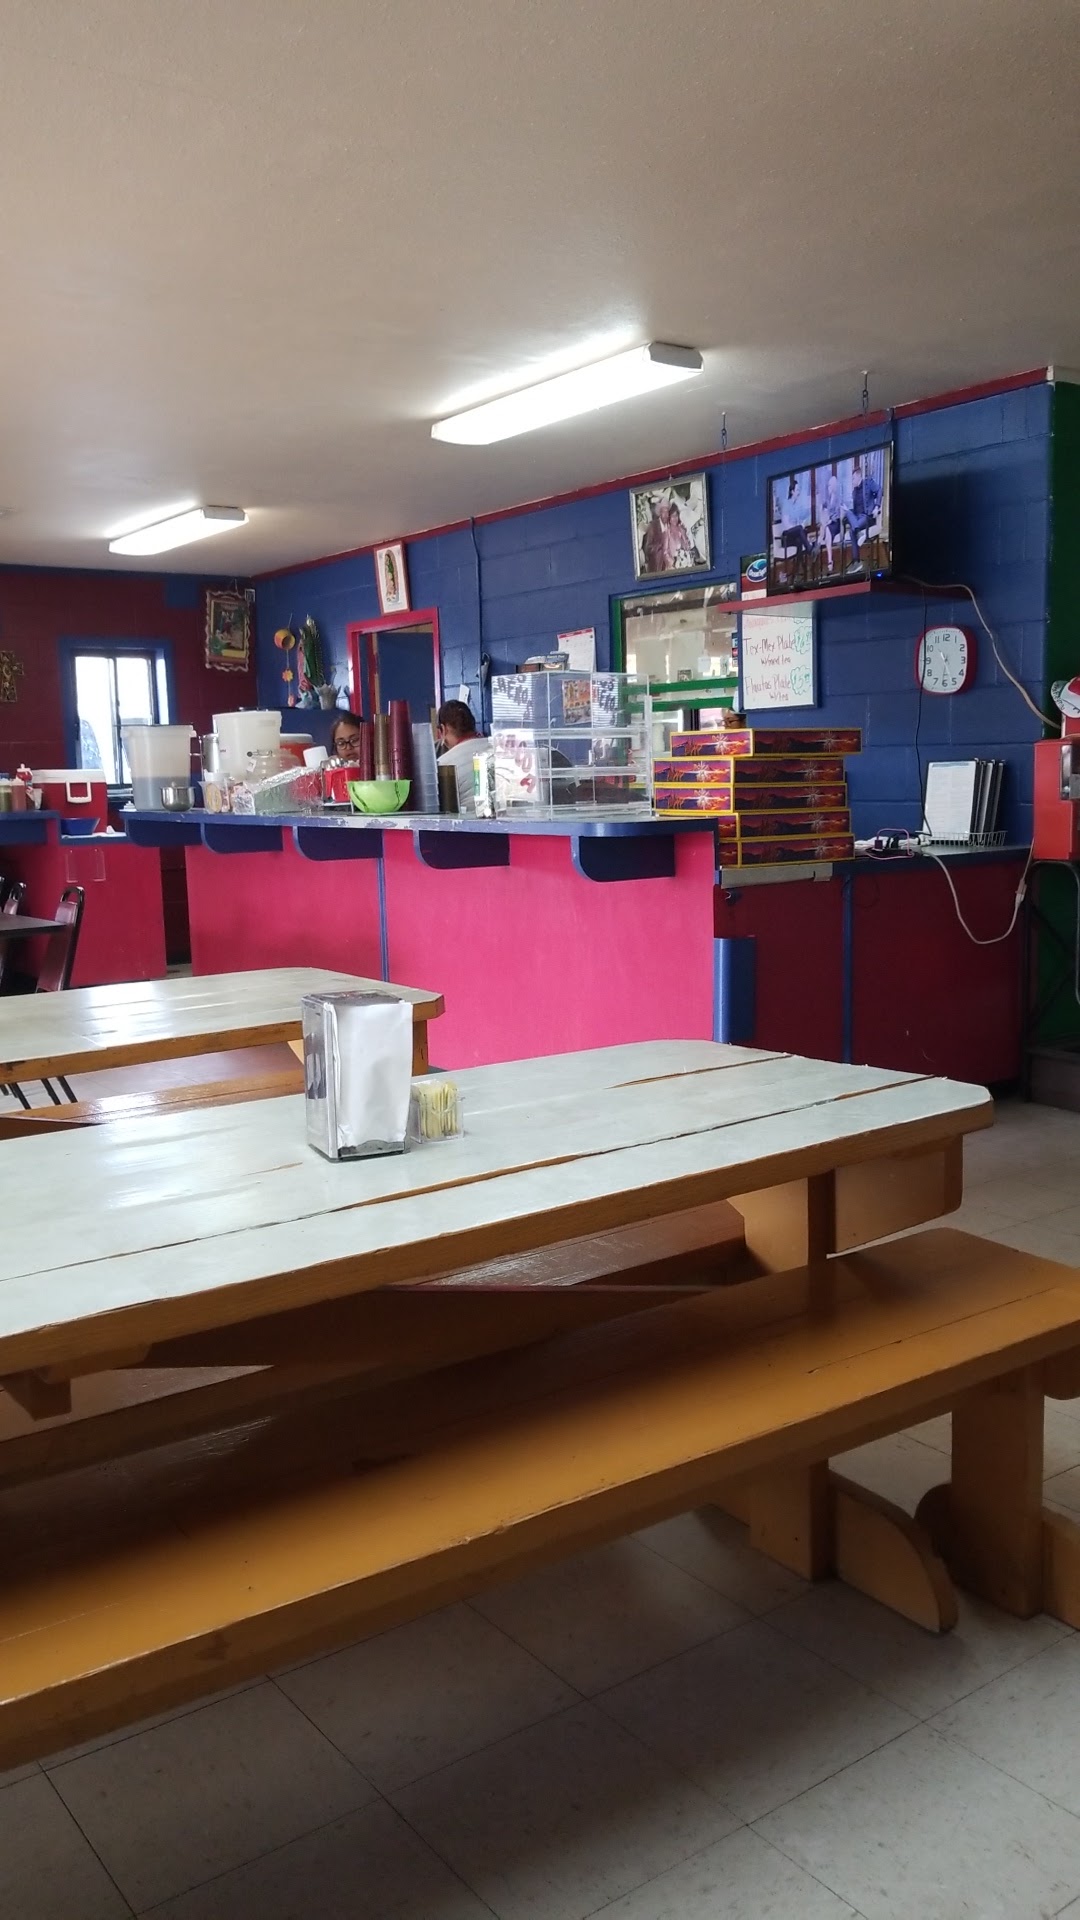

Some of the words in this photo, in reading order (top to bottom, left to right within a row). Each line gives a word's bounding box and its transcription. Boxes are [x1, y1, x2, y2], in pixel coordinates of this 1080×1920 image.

[934, 636, 940, 644] 11
[943, 634, 950, 642] 12
[926, 644, 934, 652] 10
[960, 644, 966, 652] 2
[926, 656, 932, 664] 9
[933, 678, 938, 686] 7
[942, 680, 948, 688] 6
[952, 678, 957, 686] 5
